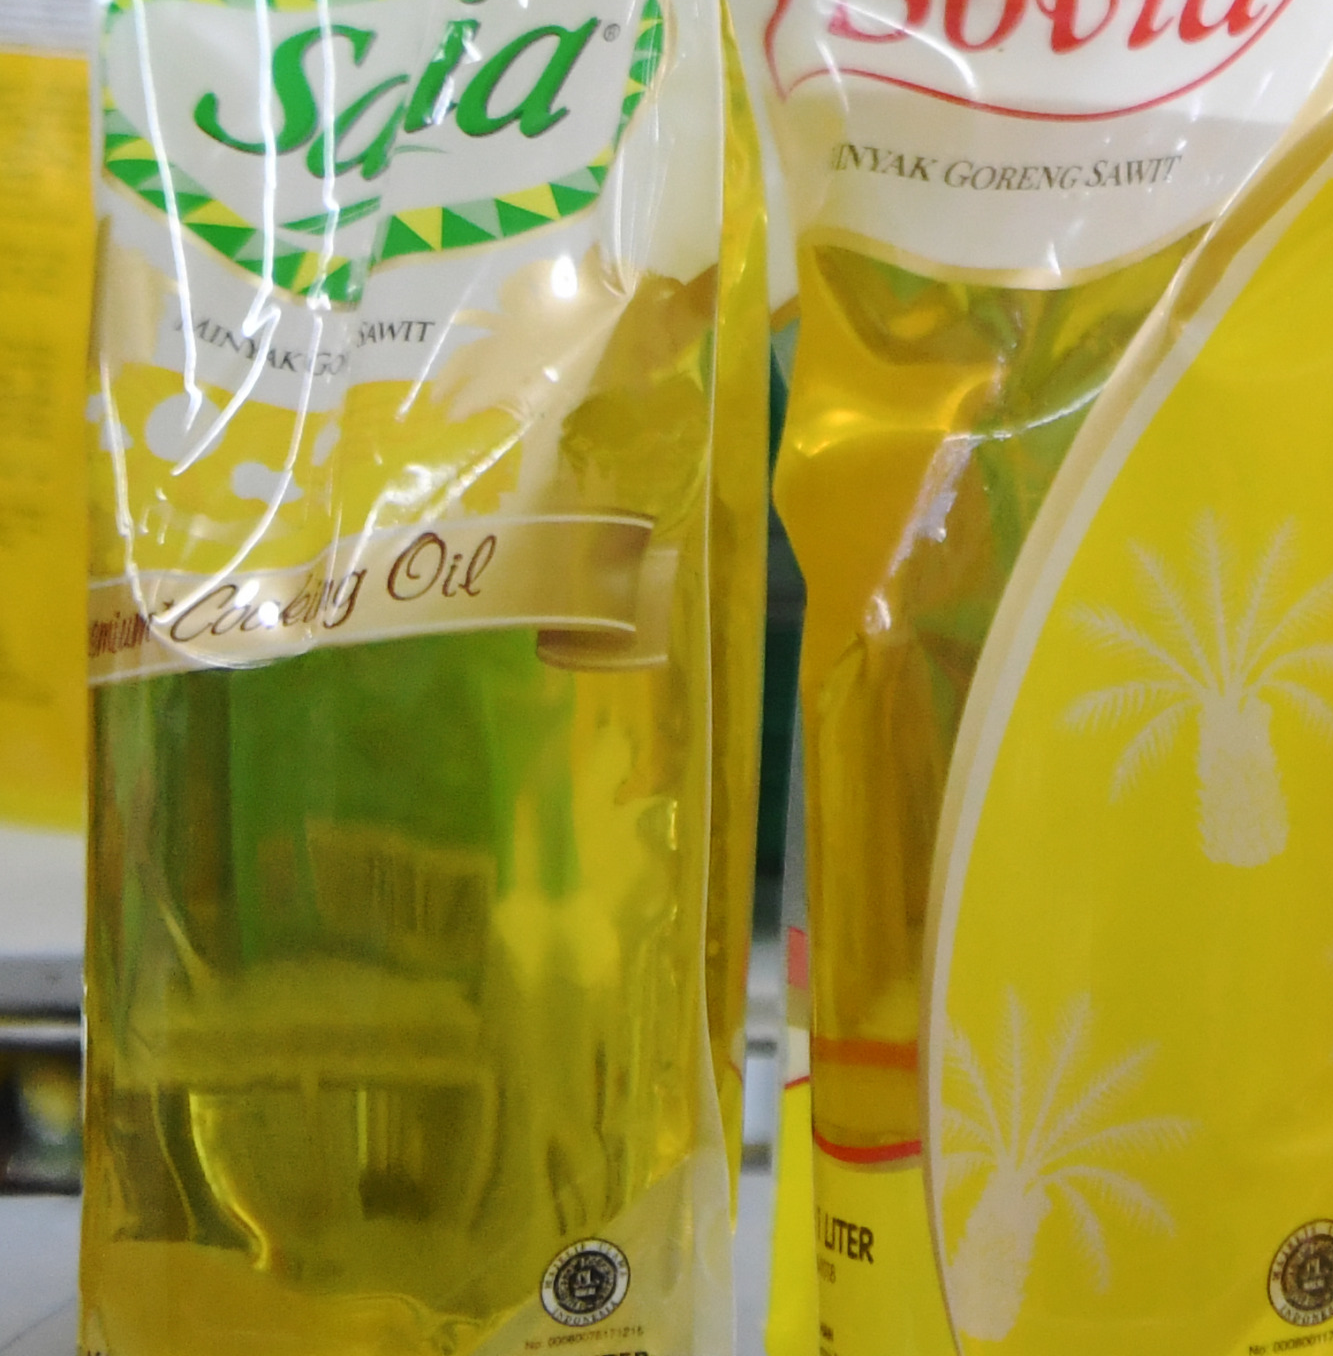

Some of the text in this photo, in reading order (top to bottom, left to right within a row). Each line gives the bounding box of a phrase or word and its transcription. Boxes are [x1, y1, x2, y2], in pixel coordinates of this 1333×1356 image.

[943, 158, 1082, 191] GORENG
[1084, 154, 1183, 188] SAWIT
[386, 530, 498, 602] Oil
[824, 1212, 875, 1265] LITER
